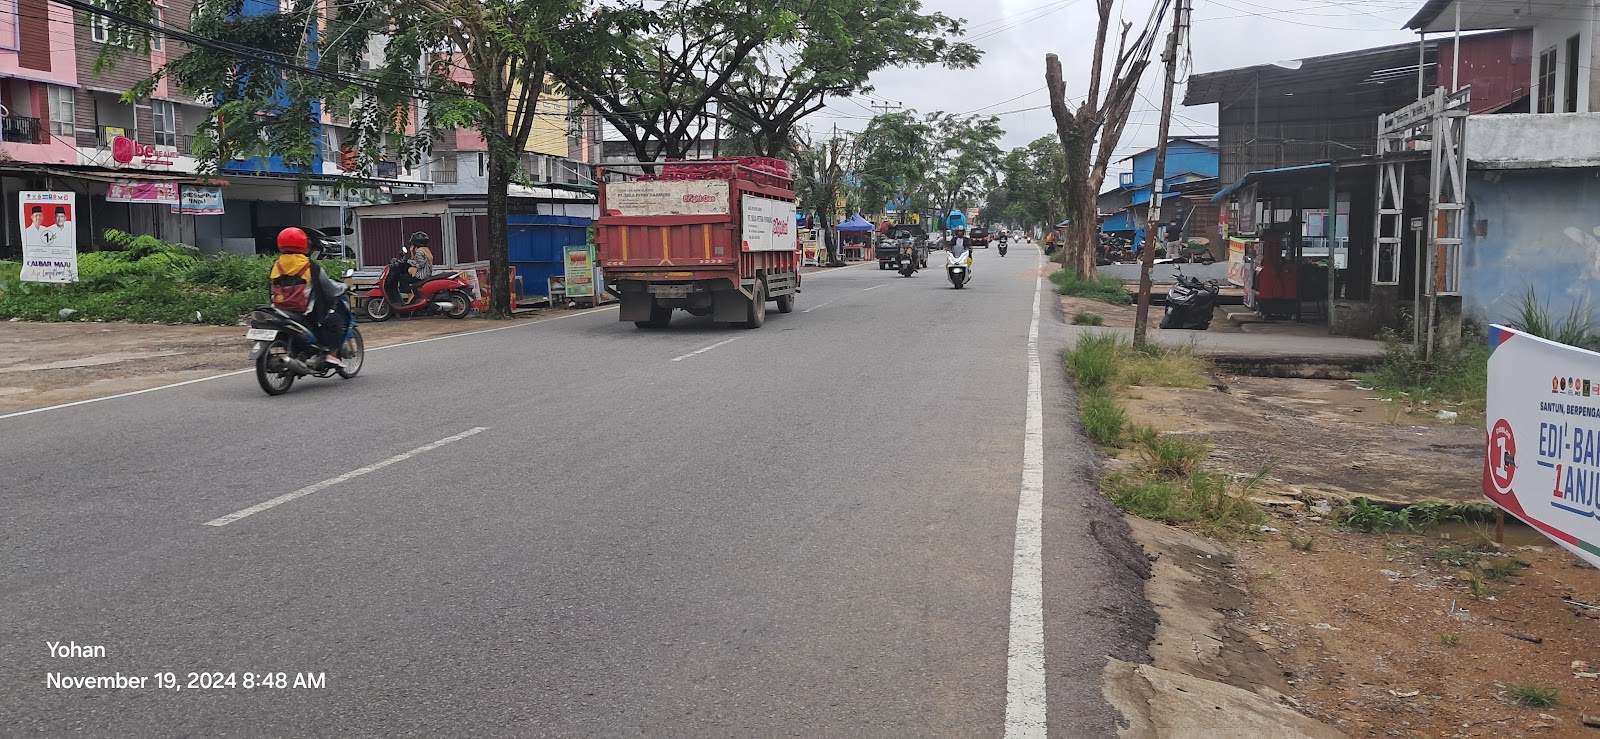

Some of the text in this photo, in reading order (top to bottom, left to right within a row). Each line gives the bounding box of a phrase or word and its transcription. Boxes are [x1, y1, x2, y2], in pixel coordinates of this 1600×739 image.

[683, 194, 716, 203] Bright Gas
[43, 232, 49, 243] 1
[54, 261, 71, 269] MAJU
[1540, 402, 1566, 415] SANTUN,
[1496, 437, 1508, 480] 1
